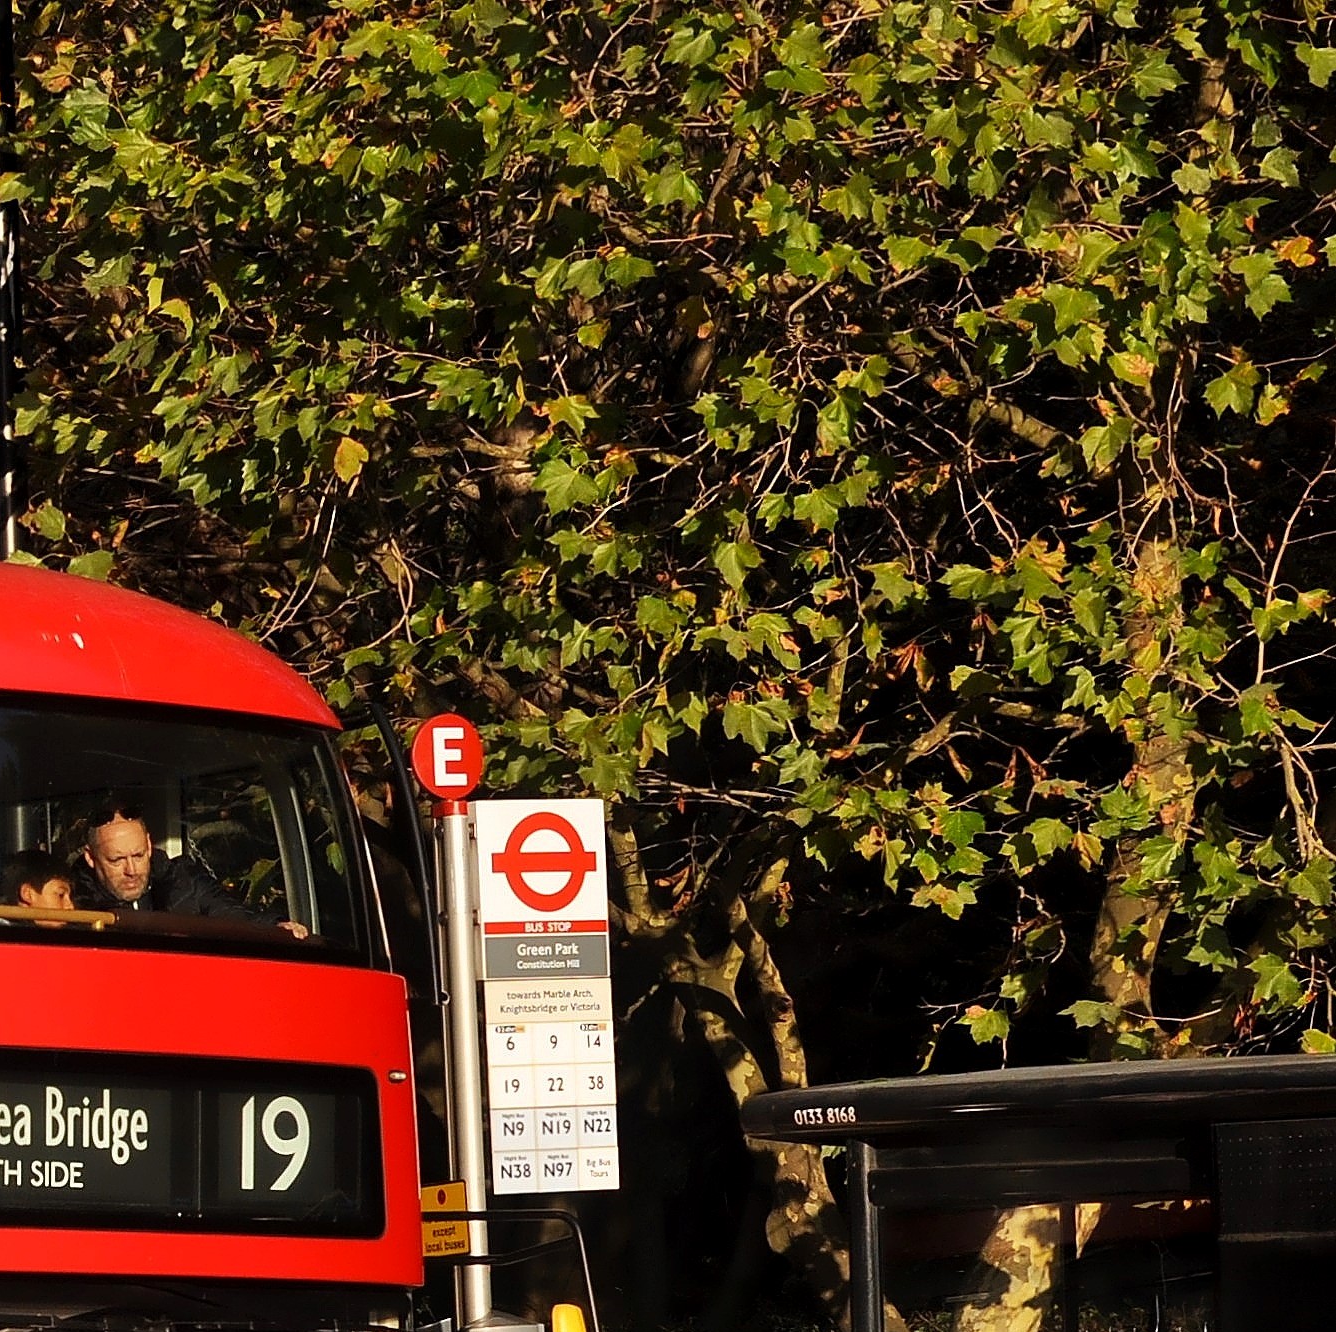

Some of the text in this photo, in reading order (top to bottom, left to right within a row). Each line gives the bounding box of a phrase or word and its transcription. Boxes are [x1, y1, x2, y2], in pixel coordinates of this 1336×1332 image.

[431, 727, 468, 787] E
[524, 922, 572, 933] BUS STOP
[517, 943, 579, 956] Green Park
[517, 959, 580, 969] Constitution Hill
[507, 991, 541, 1000] towards
[543, 990, 571, 998] Marble
[500, 1003, 557, 1015] Knightsbridge
[570, 1003, 601, 1012] Victoria
[506, 1036, 515, 1050] 6
[549, 1035, 558, 1049] 9
[587, 1034, 601, 1048] 14
[505, 1079, 520, 1093] 19
[547, 1077, 564, 1091] 22
[588, 1076, 604, 1090] 38
[794, 1106, 856, 1125] 0133 8168
[45, 1086, 149, 1165] Bridge
[503, 1121, 525, 1136] N9
[542, 1120, 571, 1135] N19
[584, 1118, 611, 1133] N22
[240, 1095, 310, 1192] 19
[544, 1162, 573, 1177] N97
[586, 1158, 611, 1167] Big Bus
[30, 1160, 85, 1188] SIDE
[501, 1164, 531, 1179] N38
[590, 1169, 608, 1177] Tours
